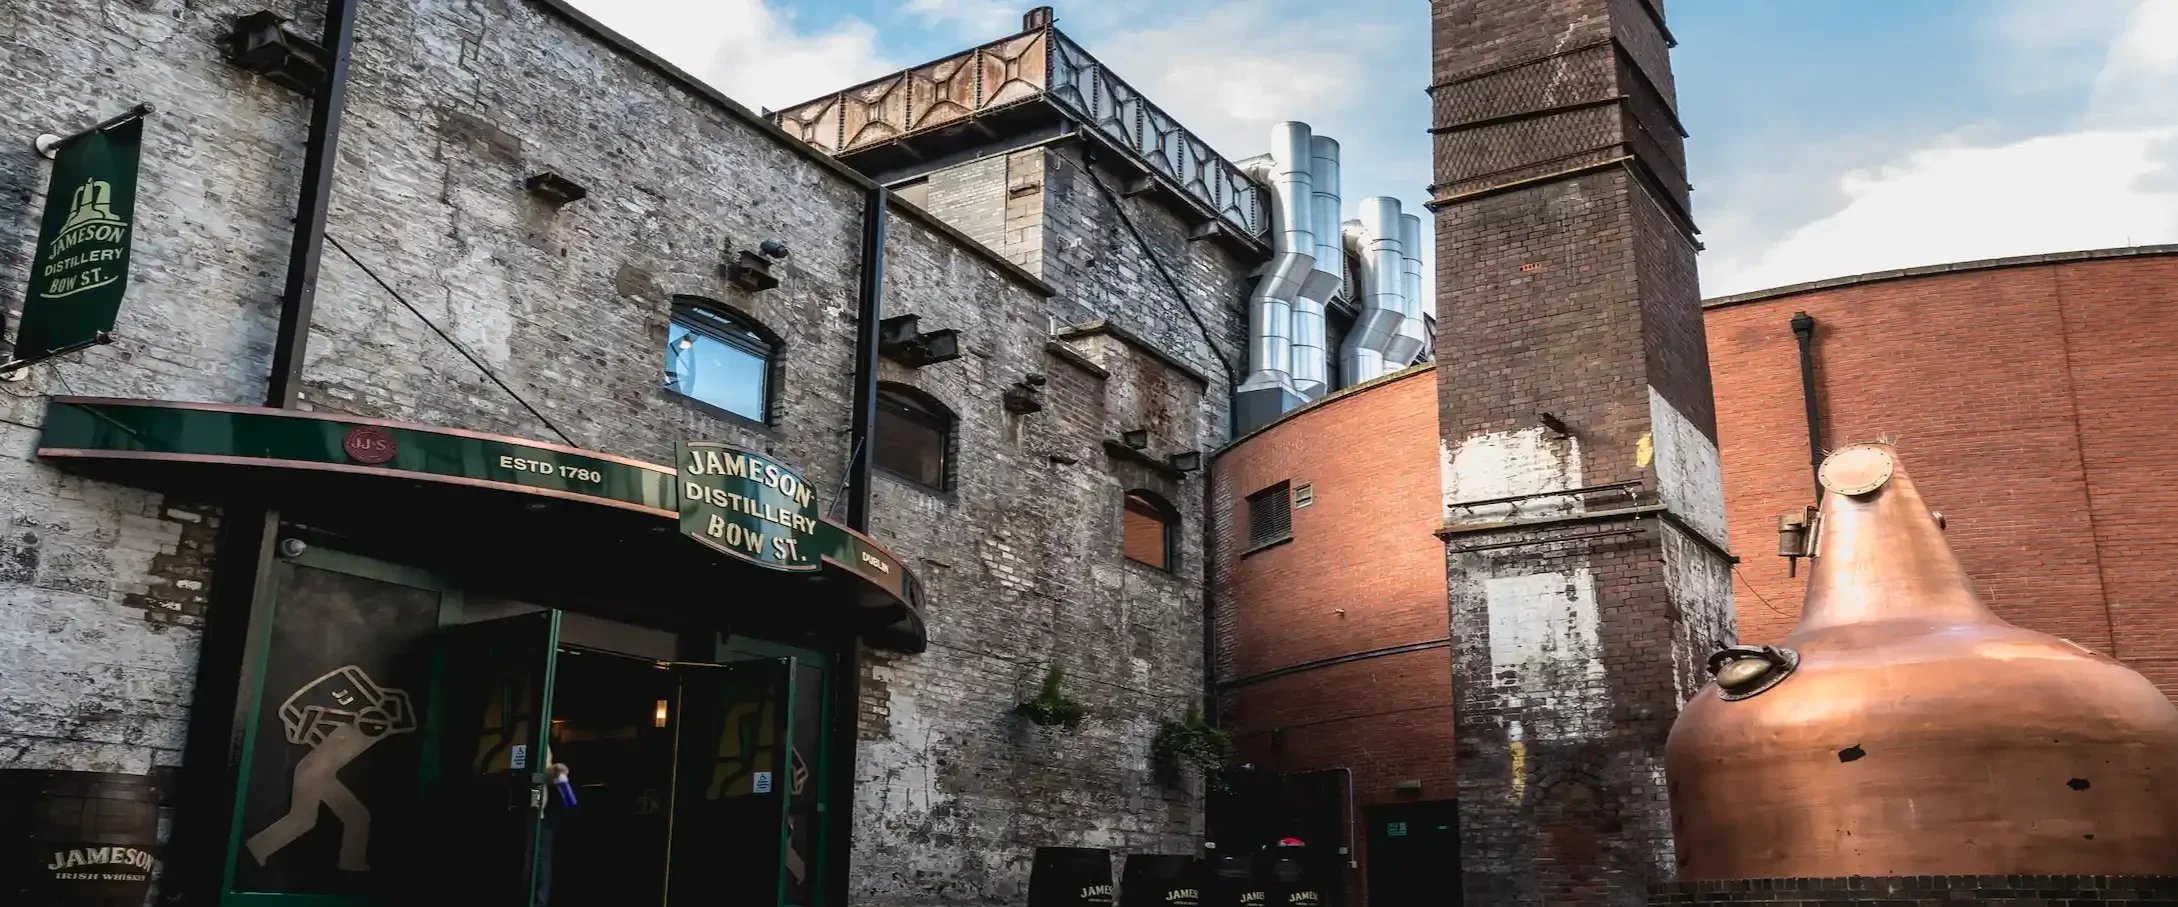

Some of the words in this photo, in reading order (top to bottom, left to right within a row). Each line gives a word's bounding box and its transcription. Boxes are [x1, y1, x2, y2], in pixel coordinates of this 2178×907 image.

[49, 225, 125, 260] JAMESON
[44, 247, 124, 276] DISTILLERY
[50, 275, 76, 293] BOW
[81, 267, 109, 285] ST.
[500, 456, 553, 475] ESTD
[558, 465, 601, 483] 1780
[687, 451, 811, 509] JAMESON
[685, 481, 817, 535] DISTILLERY
[707, 514, 764, 554] BOW
[773, 536, 807, 561] ST.
[862, 551, 889, 574] DUBLIN
[48, 847, 154, 872] JAMESON
